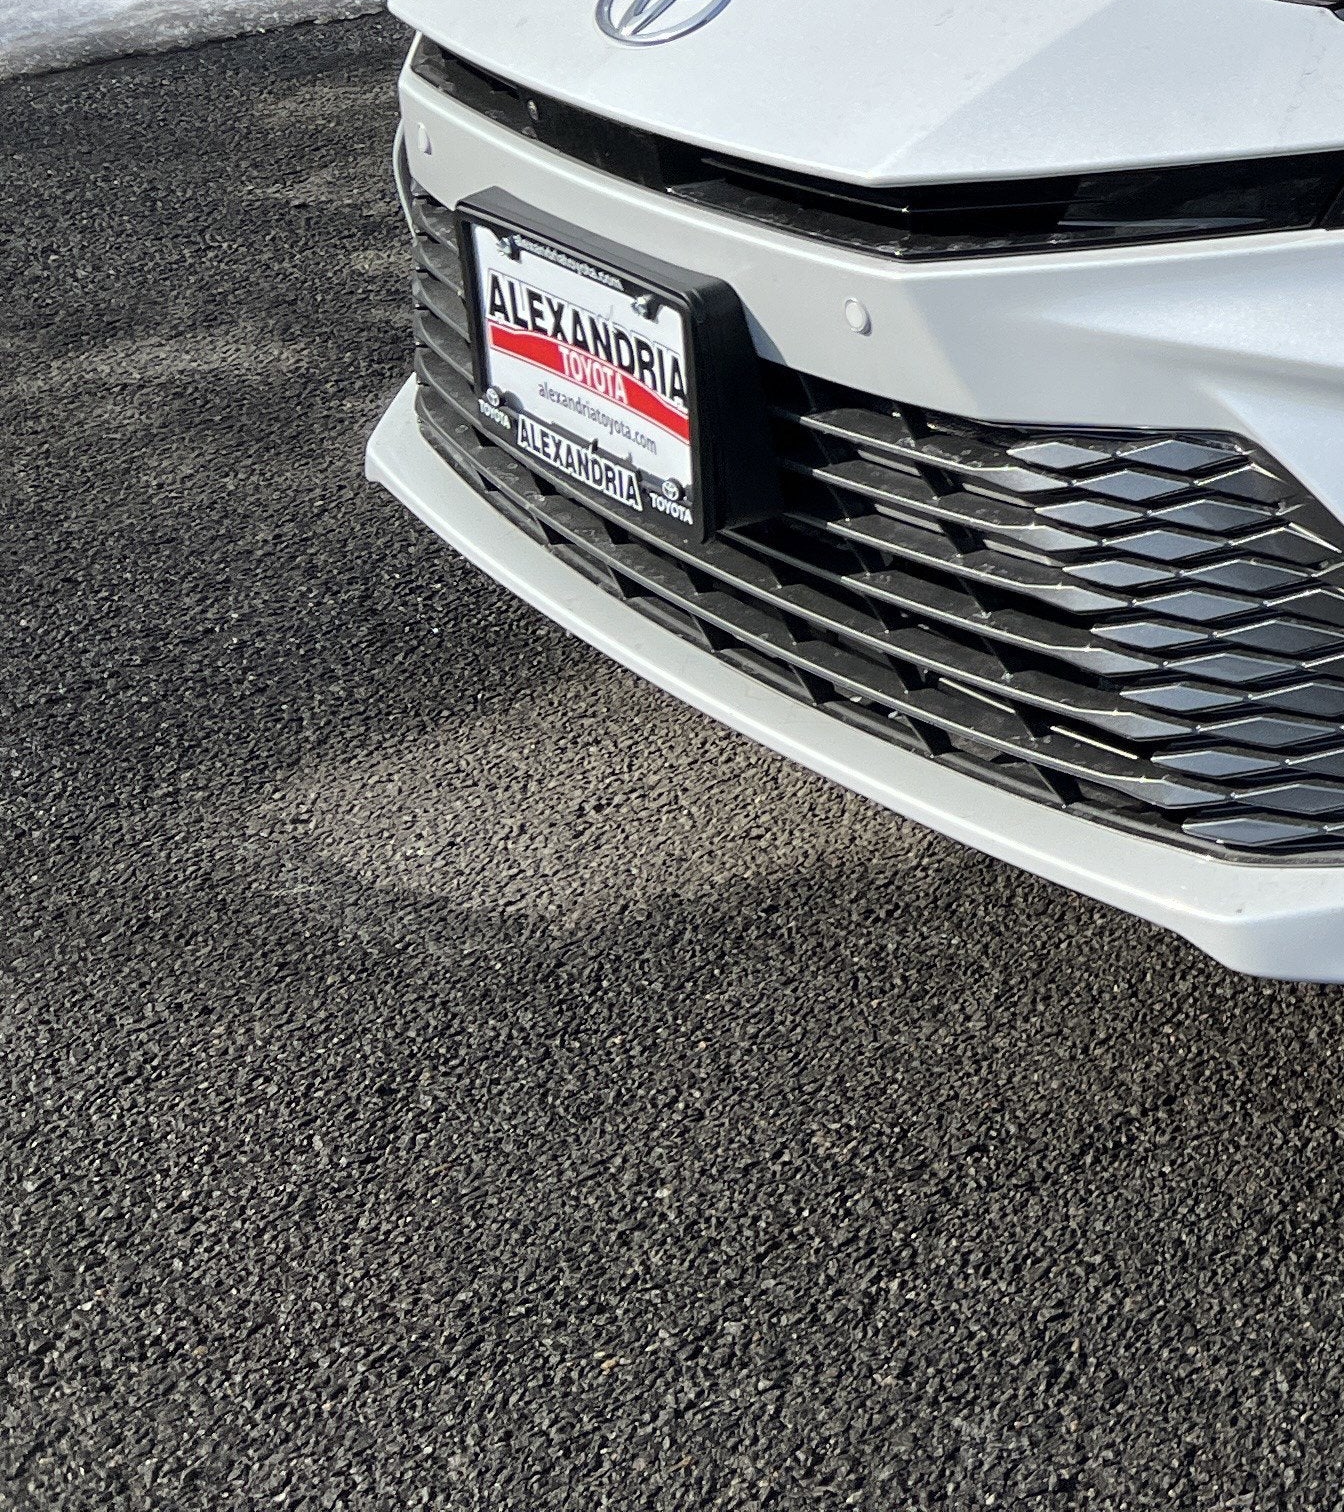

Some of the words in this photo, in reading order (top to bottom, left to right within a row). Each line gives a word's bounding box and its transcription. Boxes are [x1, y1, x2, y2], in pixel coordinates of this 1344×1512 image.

[488, 273, 688, 408] ALEXANDRIA
[558, 345, 629, 405] TOYOTA
[478, 398, 511, 429] TOYOTA
[538, 381, 657, 455] alexandriatoyota.com
[517, 414, 644, 512] ALEXANDRIA
[649, 492, 694, 525] TOYOTA
